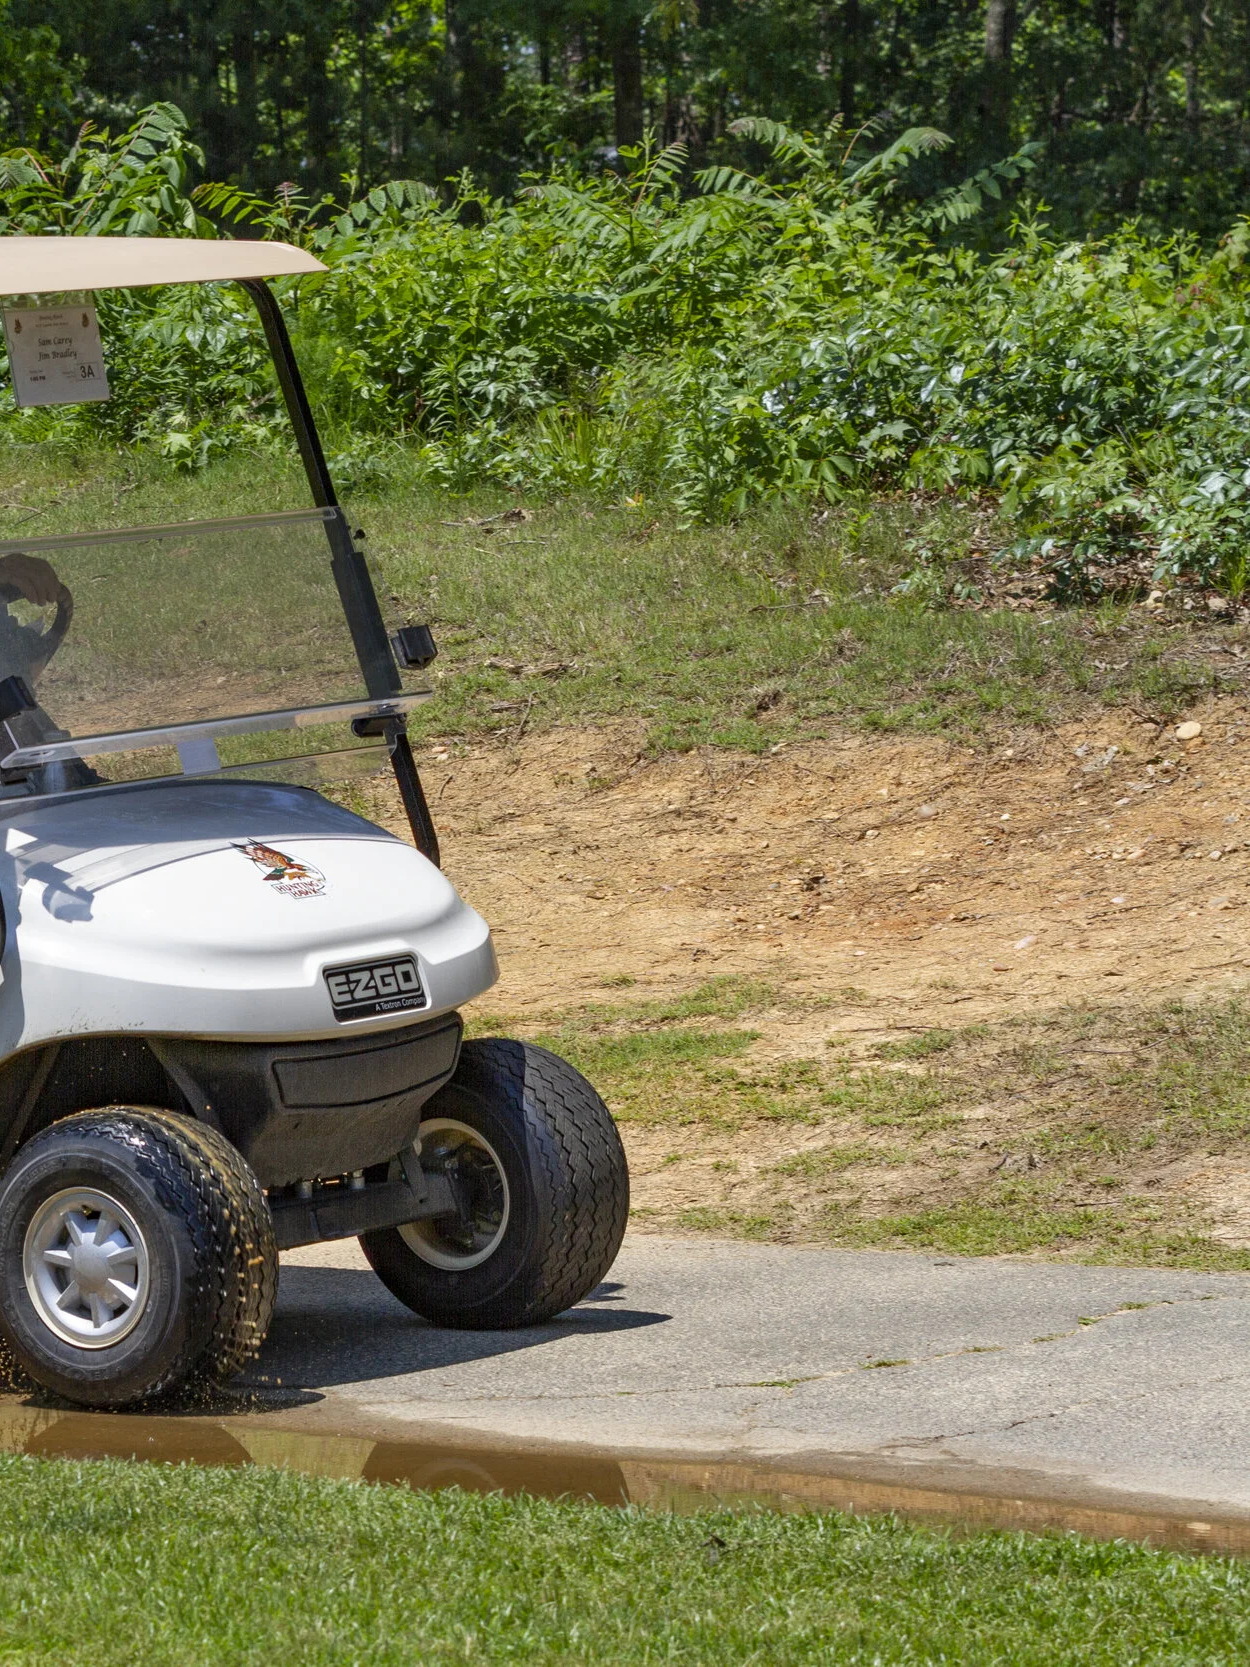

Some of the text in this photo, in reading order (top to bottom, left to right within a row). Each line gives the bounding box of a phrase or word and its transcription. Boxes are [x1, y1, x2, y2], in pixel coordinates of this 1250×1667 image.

[38, 338, 52, 347] Sam
[38, 348, 78, 362] Jim Bradley
[79, 365, 95, 379] 3A
[276, 880, 319, 892] HUNTING
[291, 888, 319, 897] HAWK
[375, 997, 426, 1012] A Textron Company
